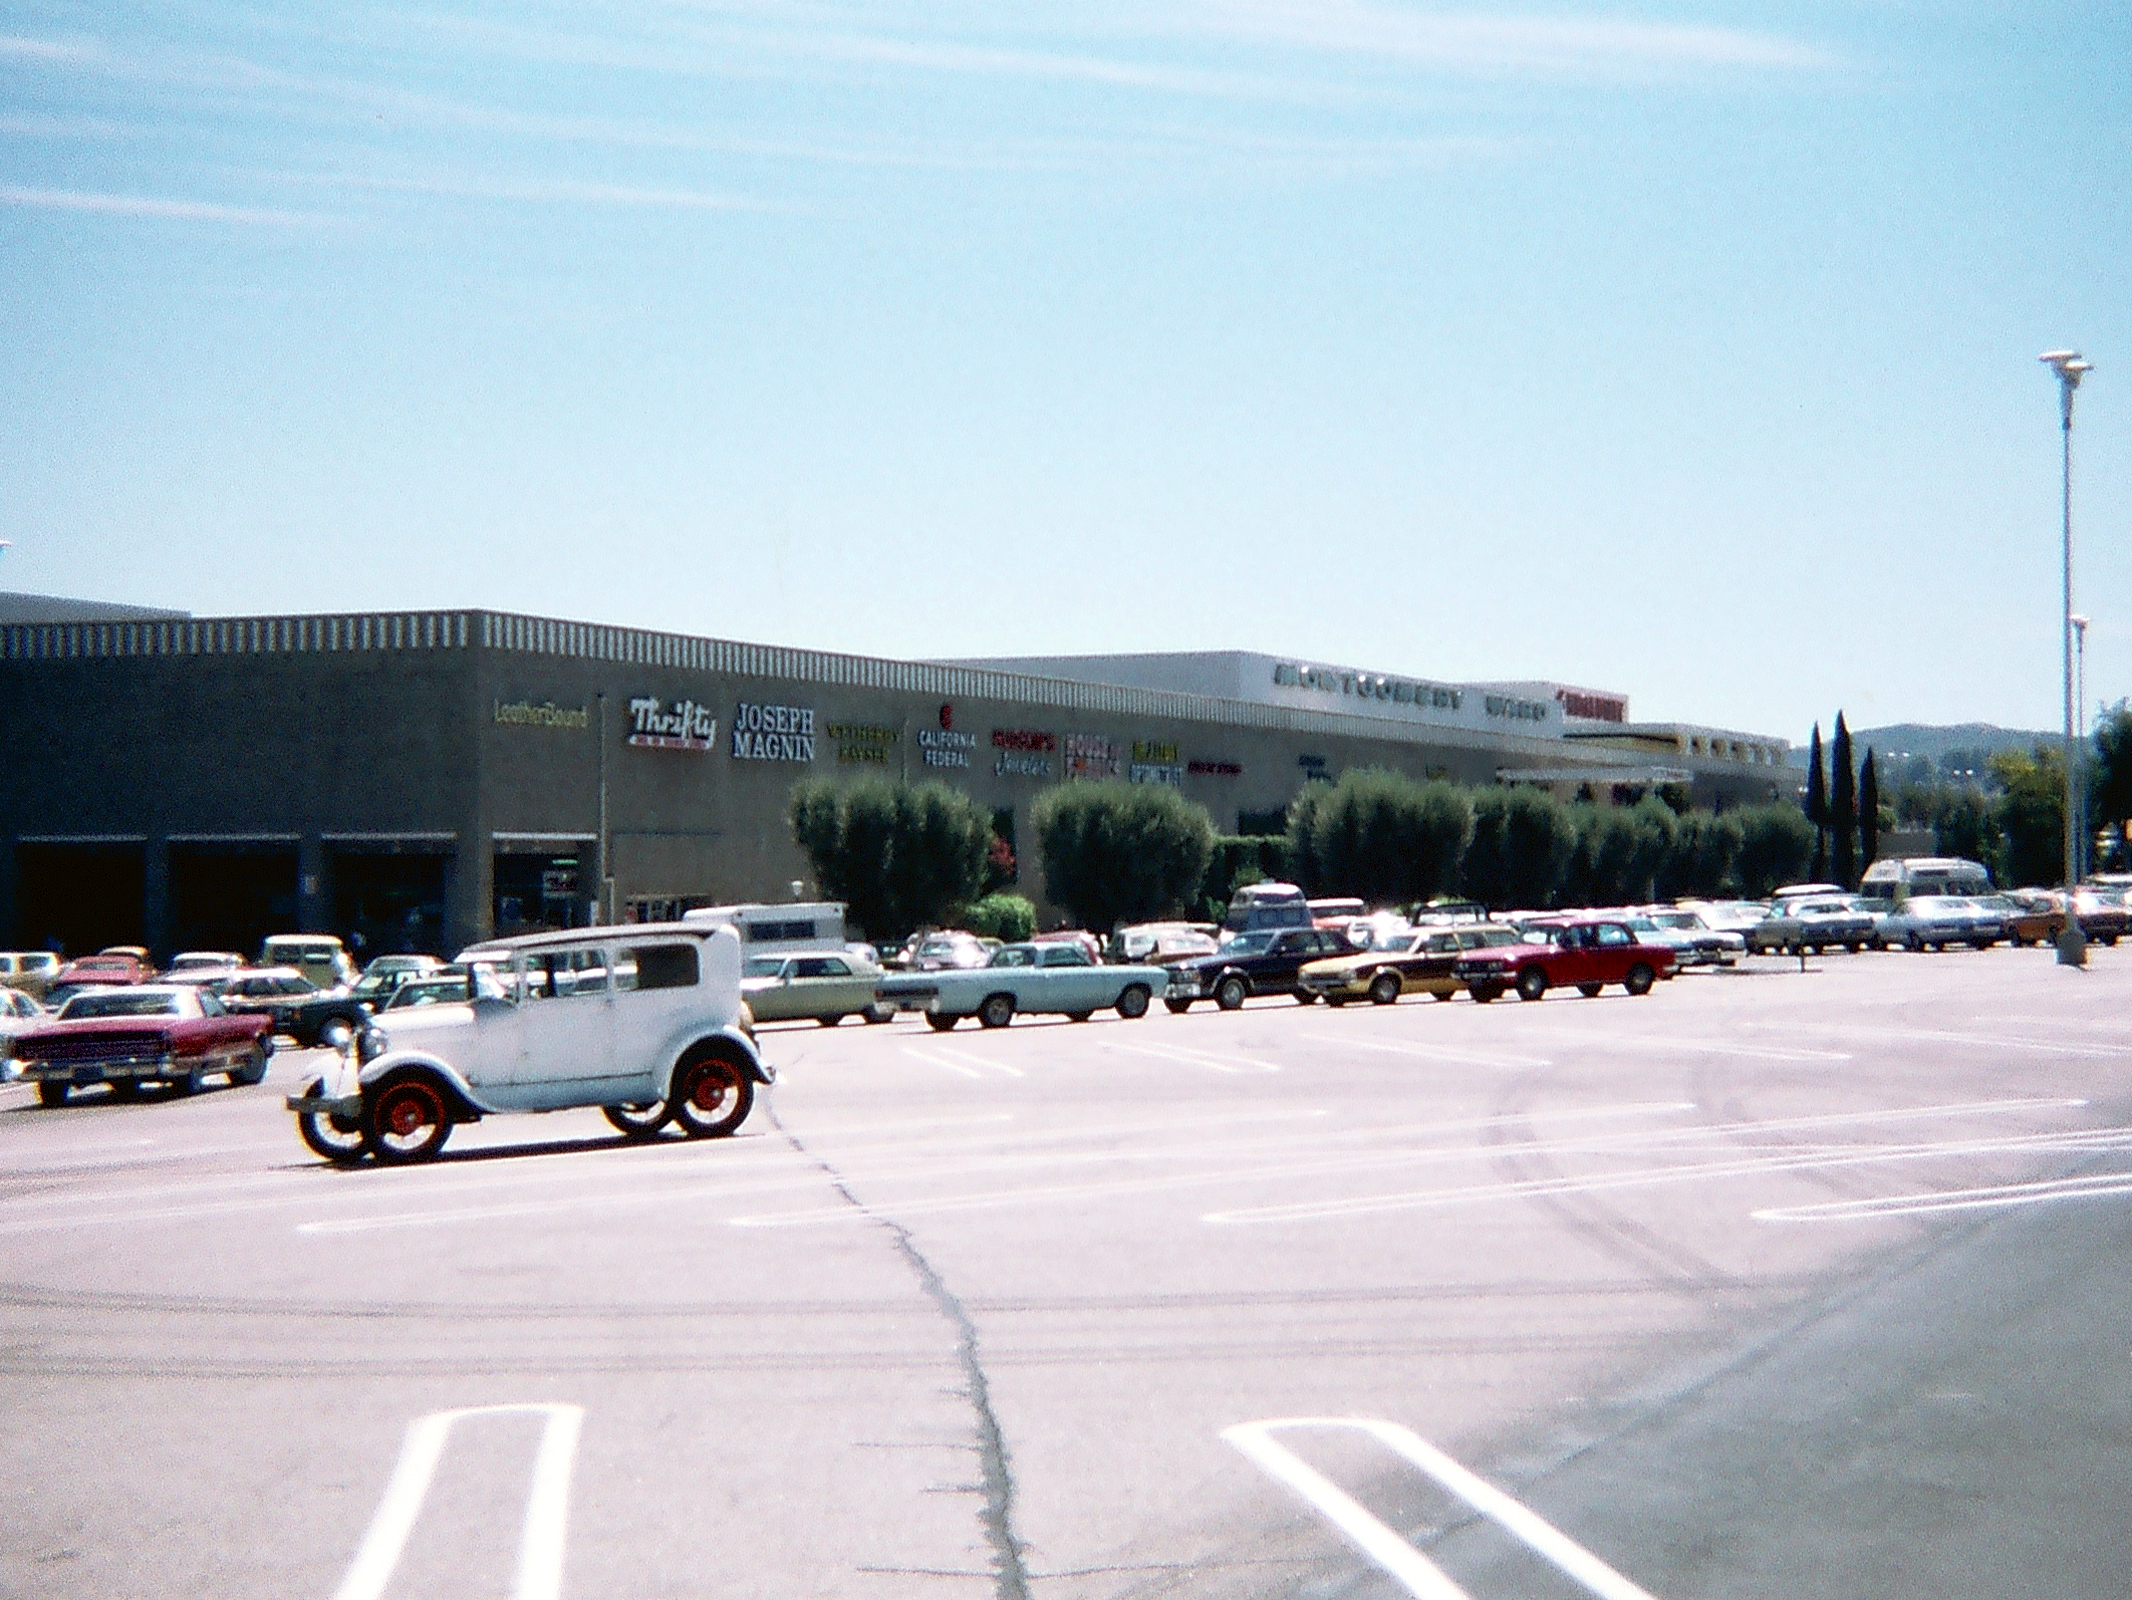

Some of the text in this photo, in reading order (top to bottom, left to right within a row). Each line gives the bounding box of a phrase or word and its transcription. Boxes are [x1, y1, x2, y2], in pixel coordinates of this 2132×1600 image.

[630, 697, 715, 749] Thrifty
[736, 703, 814, 734] JOSEPH
[733, 731, 815, 761] MAGNIN
[919, 729, 976, 748] CALIFORNIA
[924, 749, 969, 767] FEDERAL
